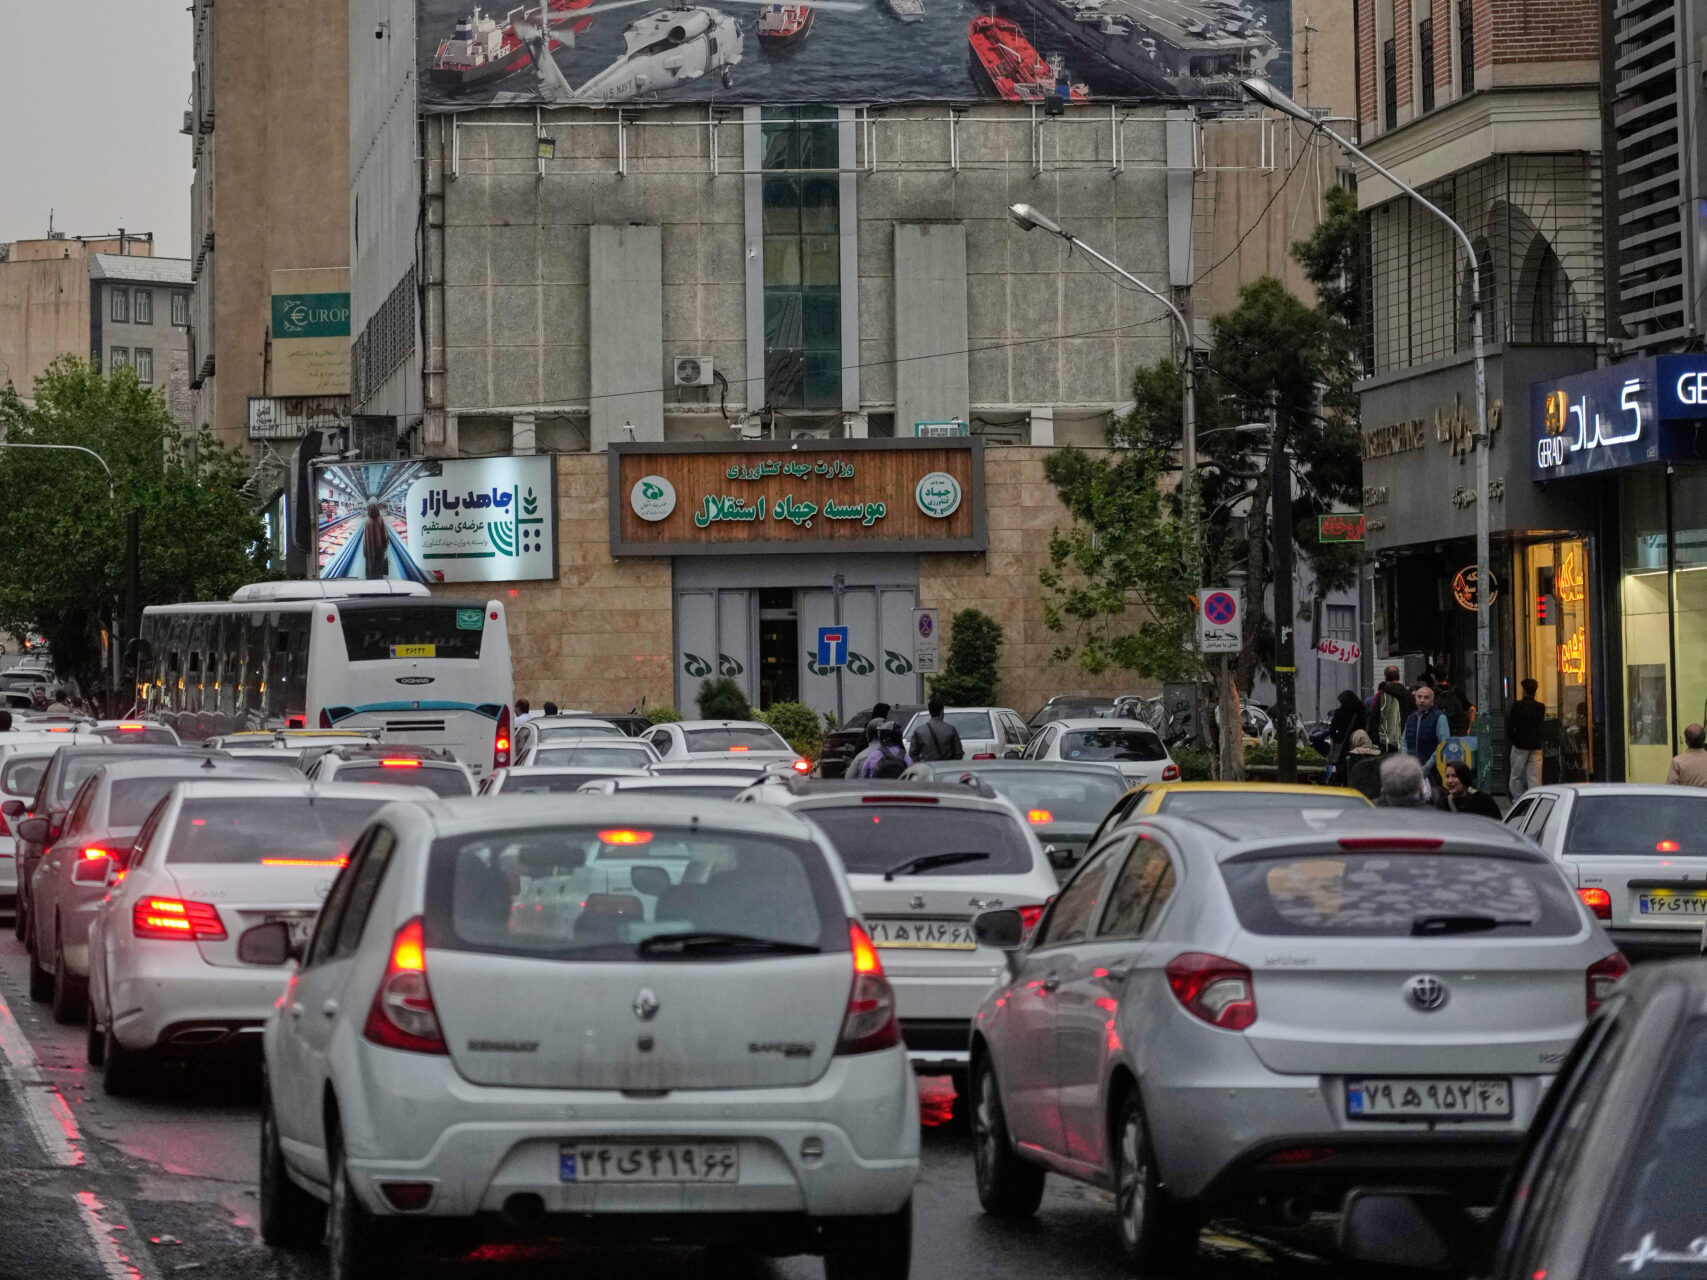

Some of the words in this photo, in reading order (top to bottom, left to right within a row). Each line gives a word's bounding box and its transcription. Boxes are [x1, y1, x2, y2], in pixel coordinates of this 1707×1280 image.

[1538, 436, 1564, 468] GERAD
[726, 459, 781, 479] کشاورزی
[783, 460, 811, 480] جهاد
[814, 460, 854, 478] وزارت
[925, 487, 951, 498] جهاد
[695, 494, 765, 527] استقلال
[773, 494, 818, 529] جهاد
[824, 498, 886, 526] موسسه
[422, 521, 453, 536] مستقیم
[1319, 639, 1361, 662] داروخانه
